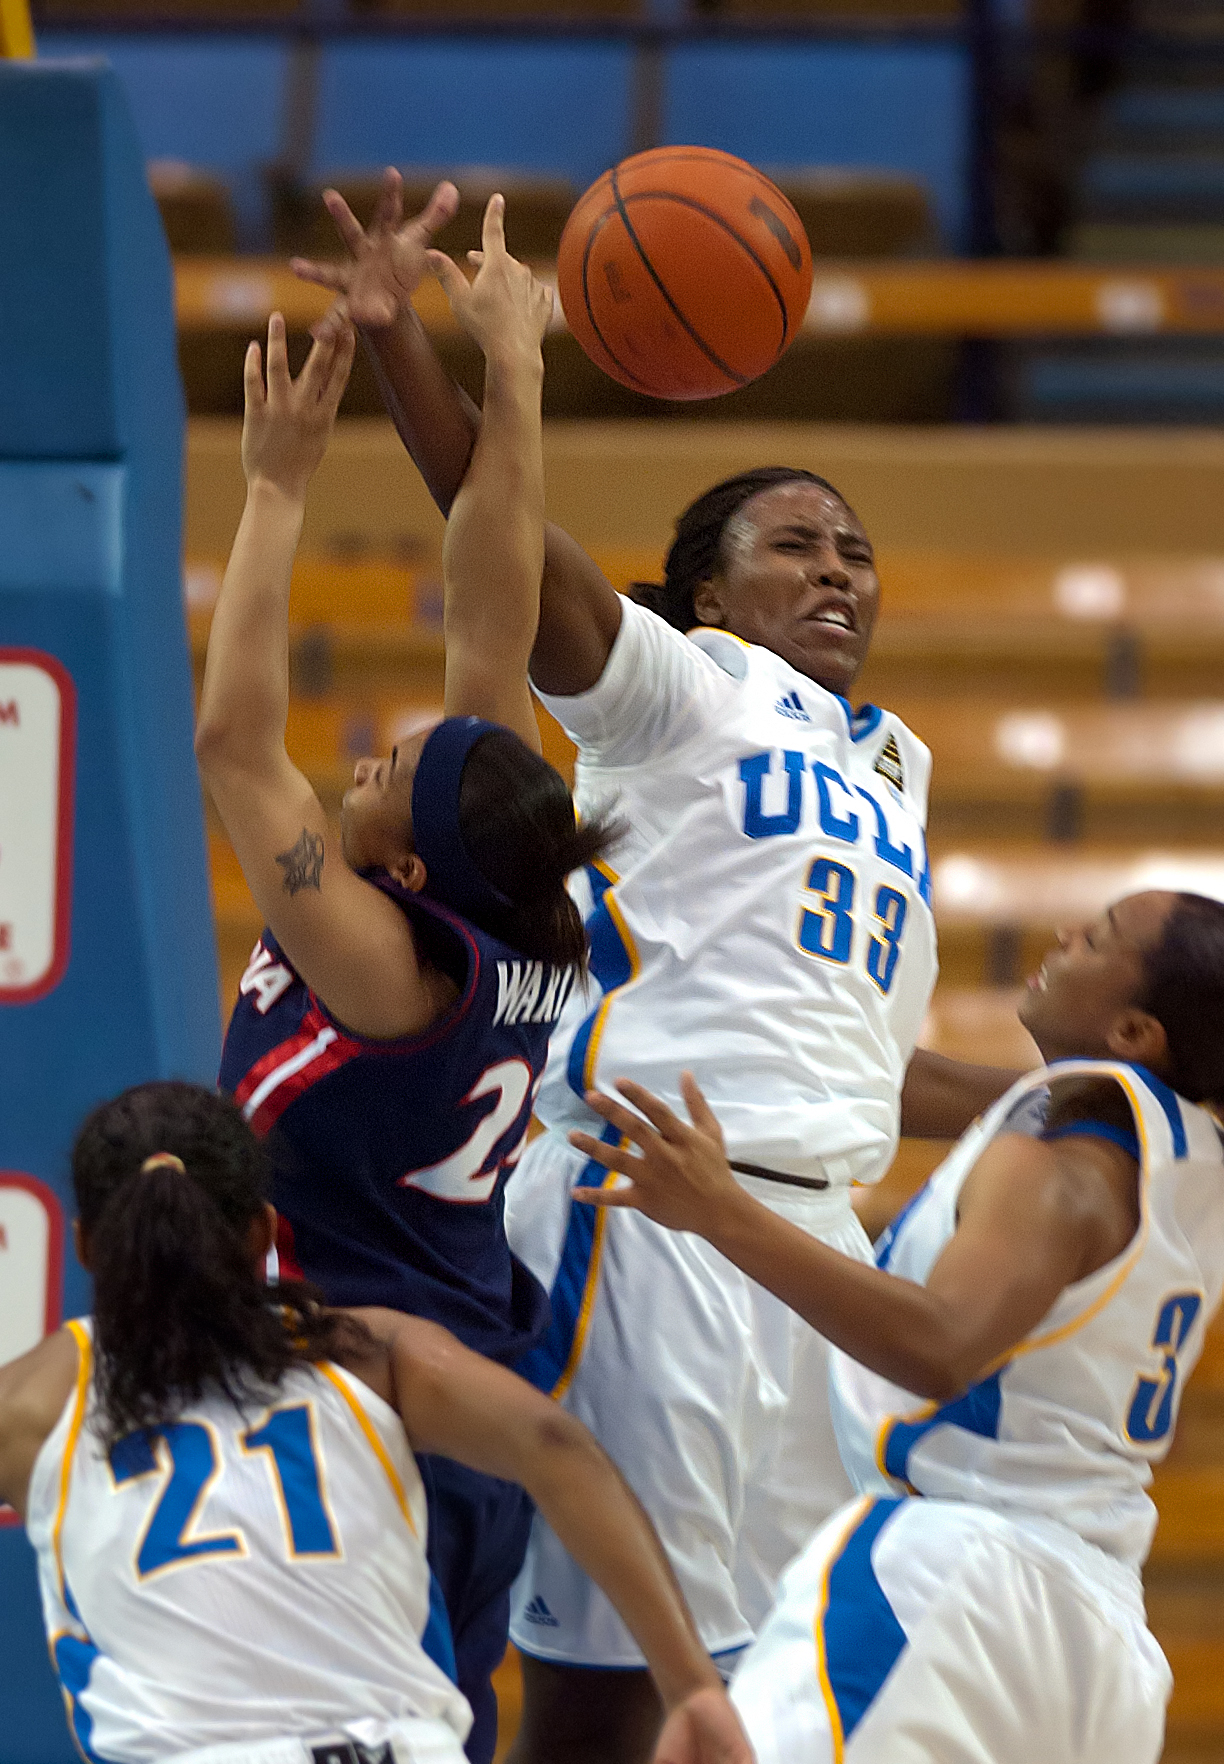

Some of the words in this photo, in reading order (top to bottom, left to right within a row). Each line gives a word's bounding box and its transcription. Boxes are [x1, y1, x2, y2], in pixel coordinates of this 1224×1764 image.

[796, 855, 910, 996] 33
[397, 1055, 543, 1205] 2
[1122, 1288, 1203, 1444] 3
[107, 1400, 342, 1583] 21
